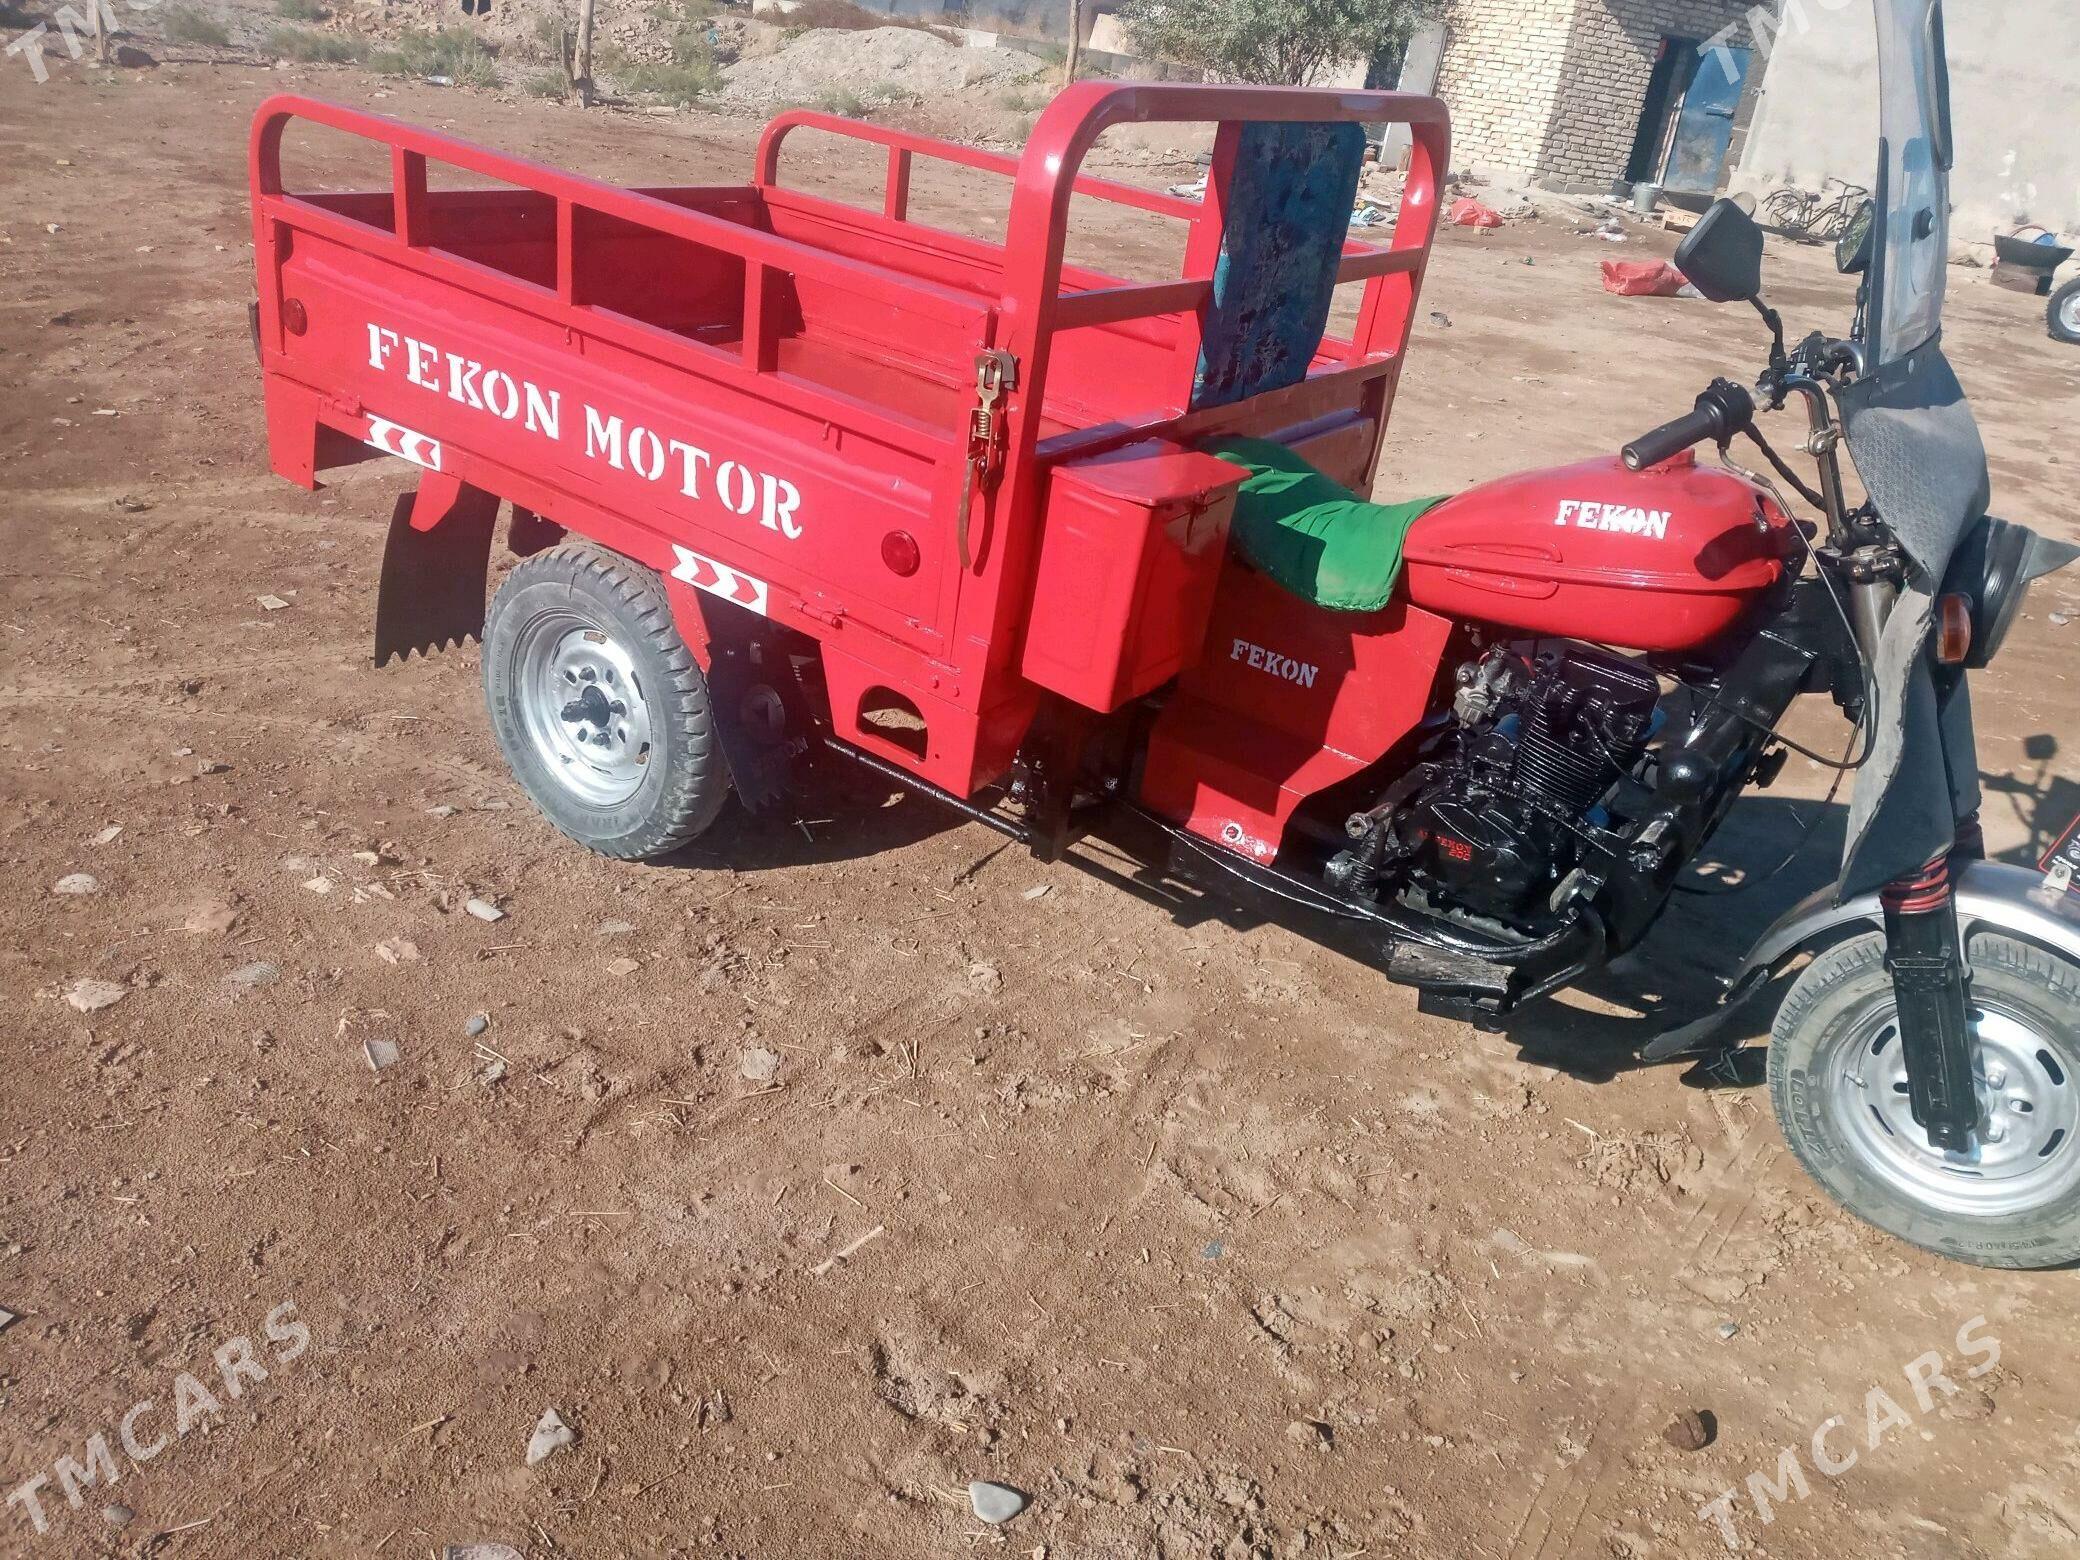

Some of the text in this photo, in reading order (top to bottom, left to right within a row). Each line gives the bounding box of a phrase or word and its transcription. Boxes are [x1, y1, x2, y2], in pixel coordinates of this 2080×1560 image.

[367, 323, 803, 540] FEKON MOTOR
[1554, 499, 1673, 540] FEKON
[1230, 638, 1319, 688] FEKON
